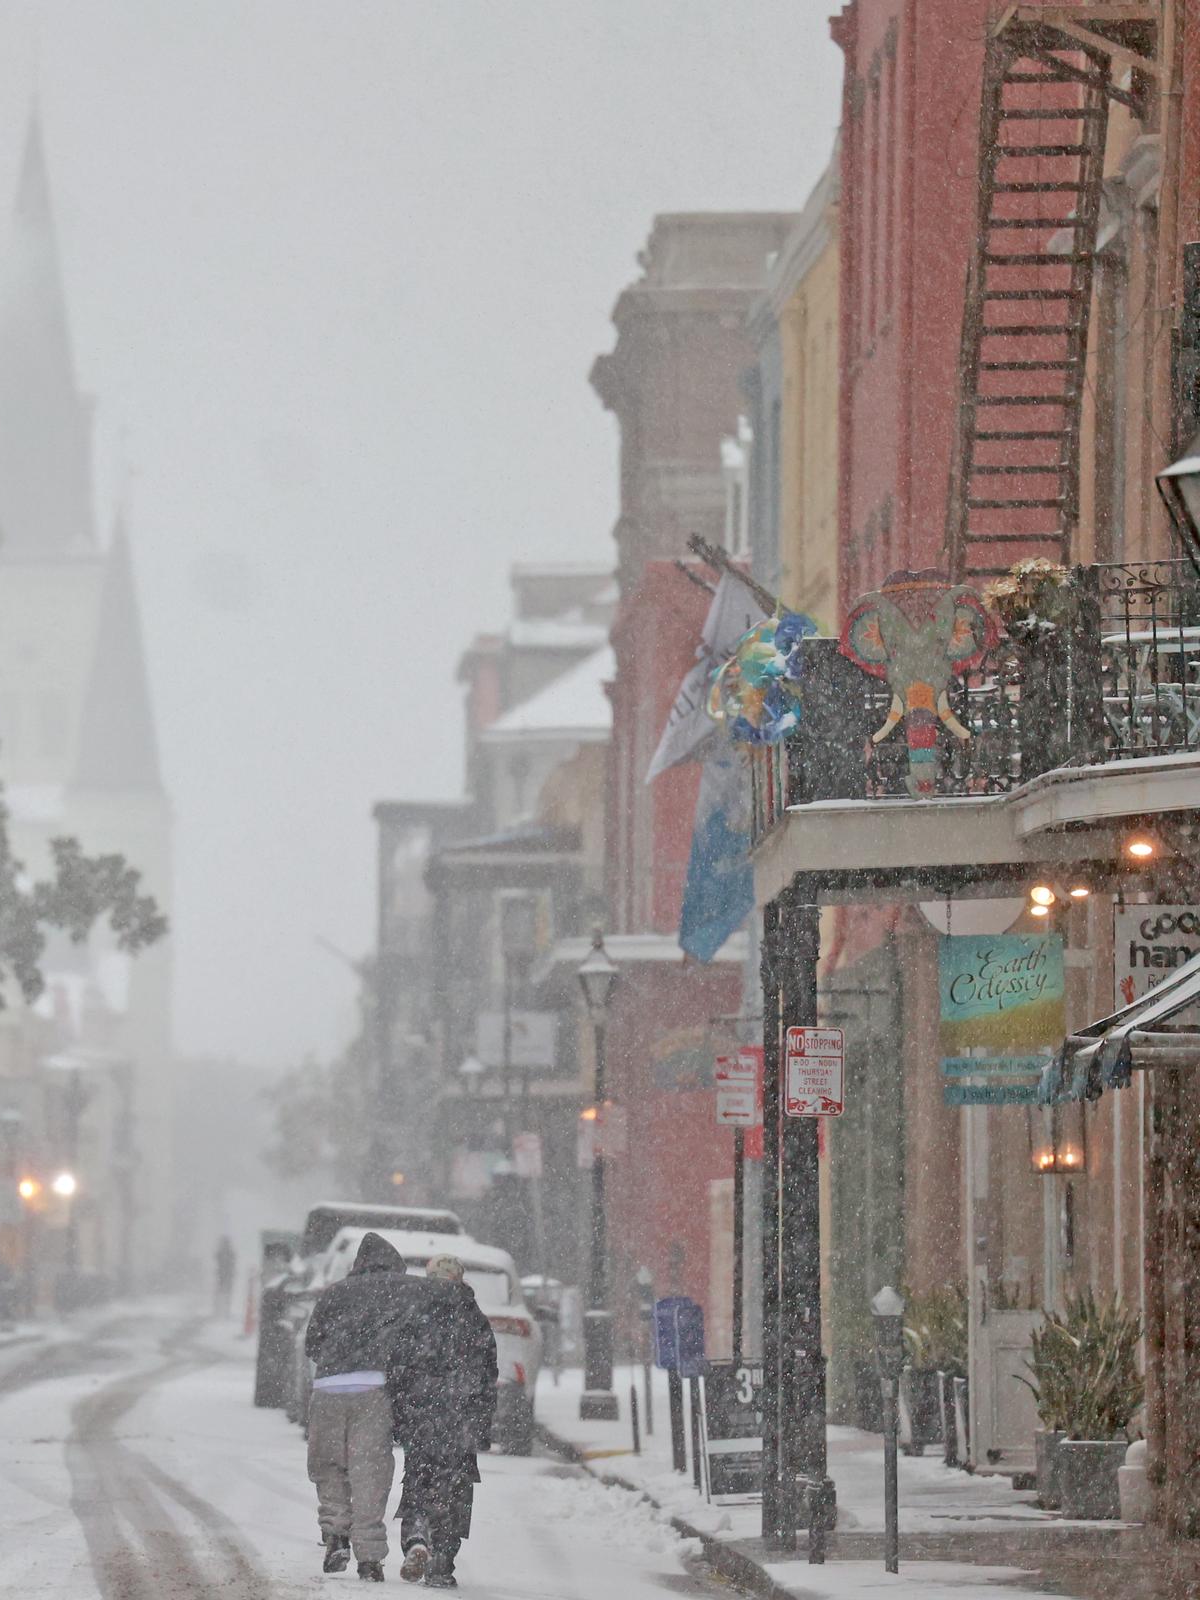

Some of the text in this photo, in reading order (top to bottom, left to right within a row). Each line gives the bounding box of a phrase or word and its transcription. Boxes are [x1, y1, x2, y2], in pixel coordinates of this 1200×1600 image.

[977, 941, 1047, 980] Earth
[950, 973, 1048, 1010] Odyssey
[788, 1033, 842, 1052] NO STOPPING
[798, 1068, 833, 1077] THURSDAY
[803, 1078, 828, 1086] STREET
